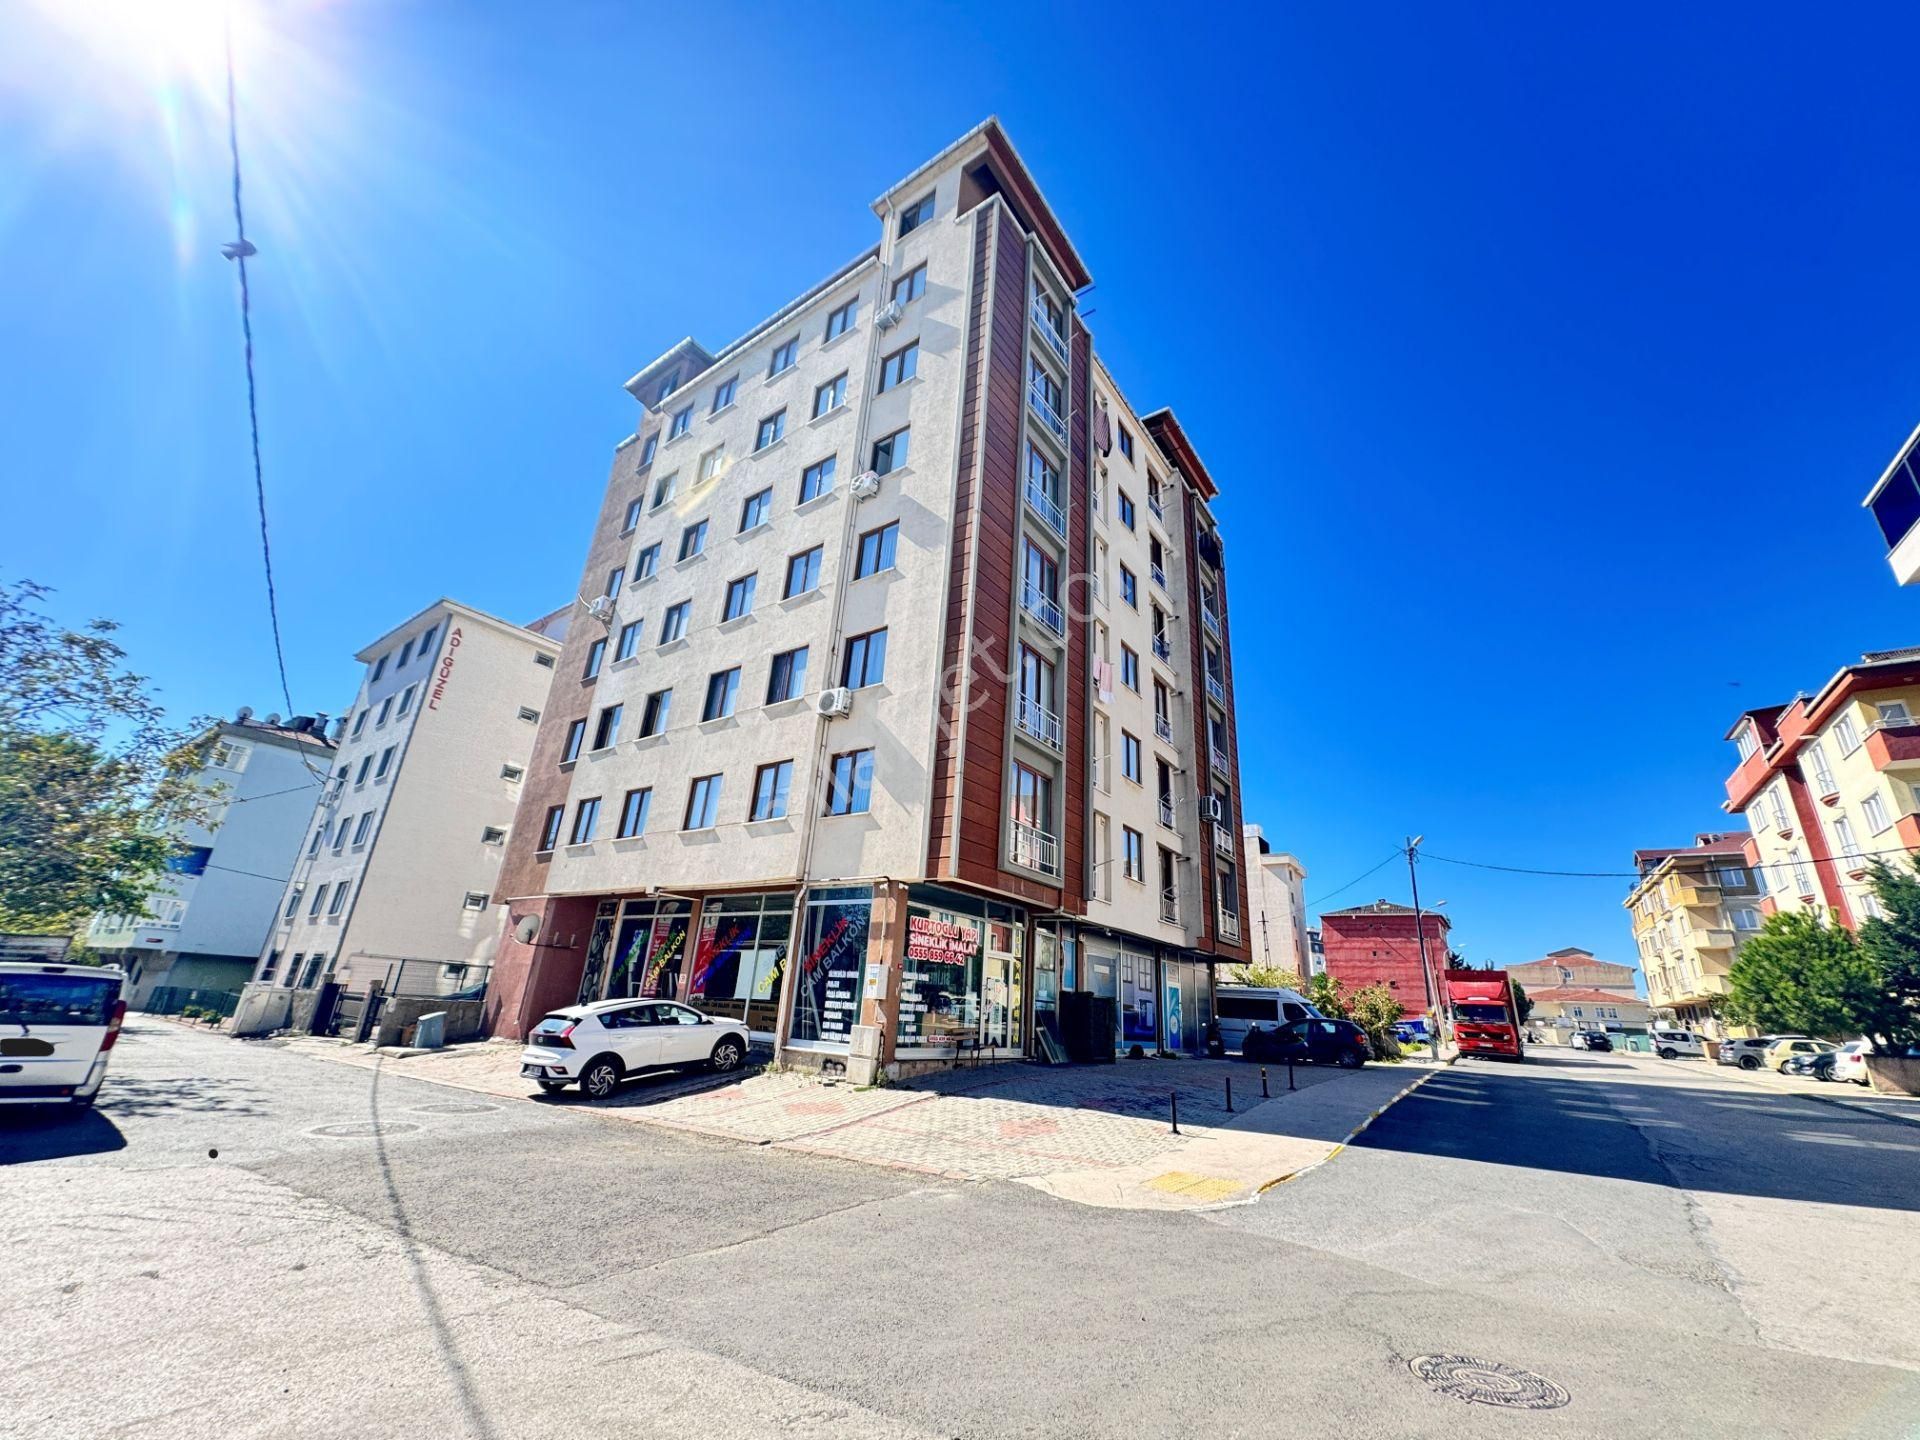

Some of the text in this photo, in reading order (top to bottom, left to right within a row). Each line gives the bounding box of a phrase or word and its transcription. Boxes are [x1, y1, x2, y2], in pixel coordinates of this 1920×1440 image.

[909, 933, 948, 950] SİNEKLİK
[961, 928, 979, 944] YAPI
[658, 930, 686, 968] BALKON
[909, 947, 929, 959] 0555
[929, 951, 944, 962] 859
[944, 952, 955, 964] 66
[758, 967, 779, 993] CAM
[801, 969, 824, 997] CAM
